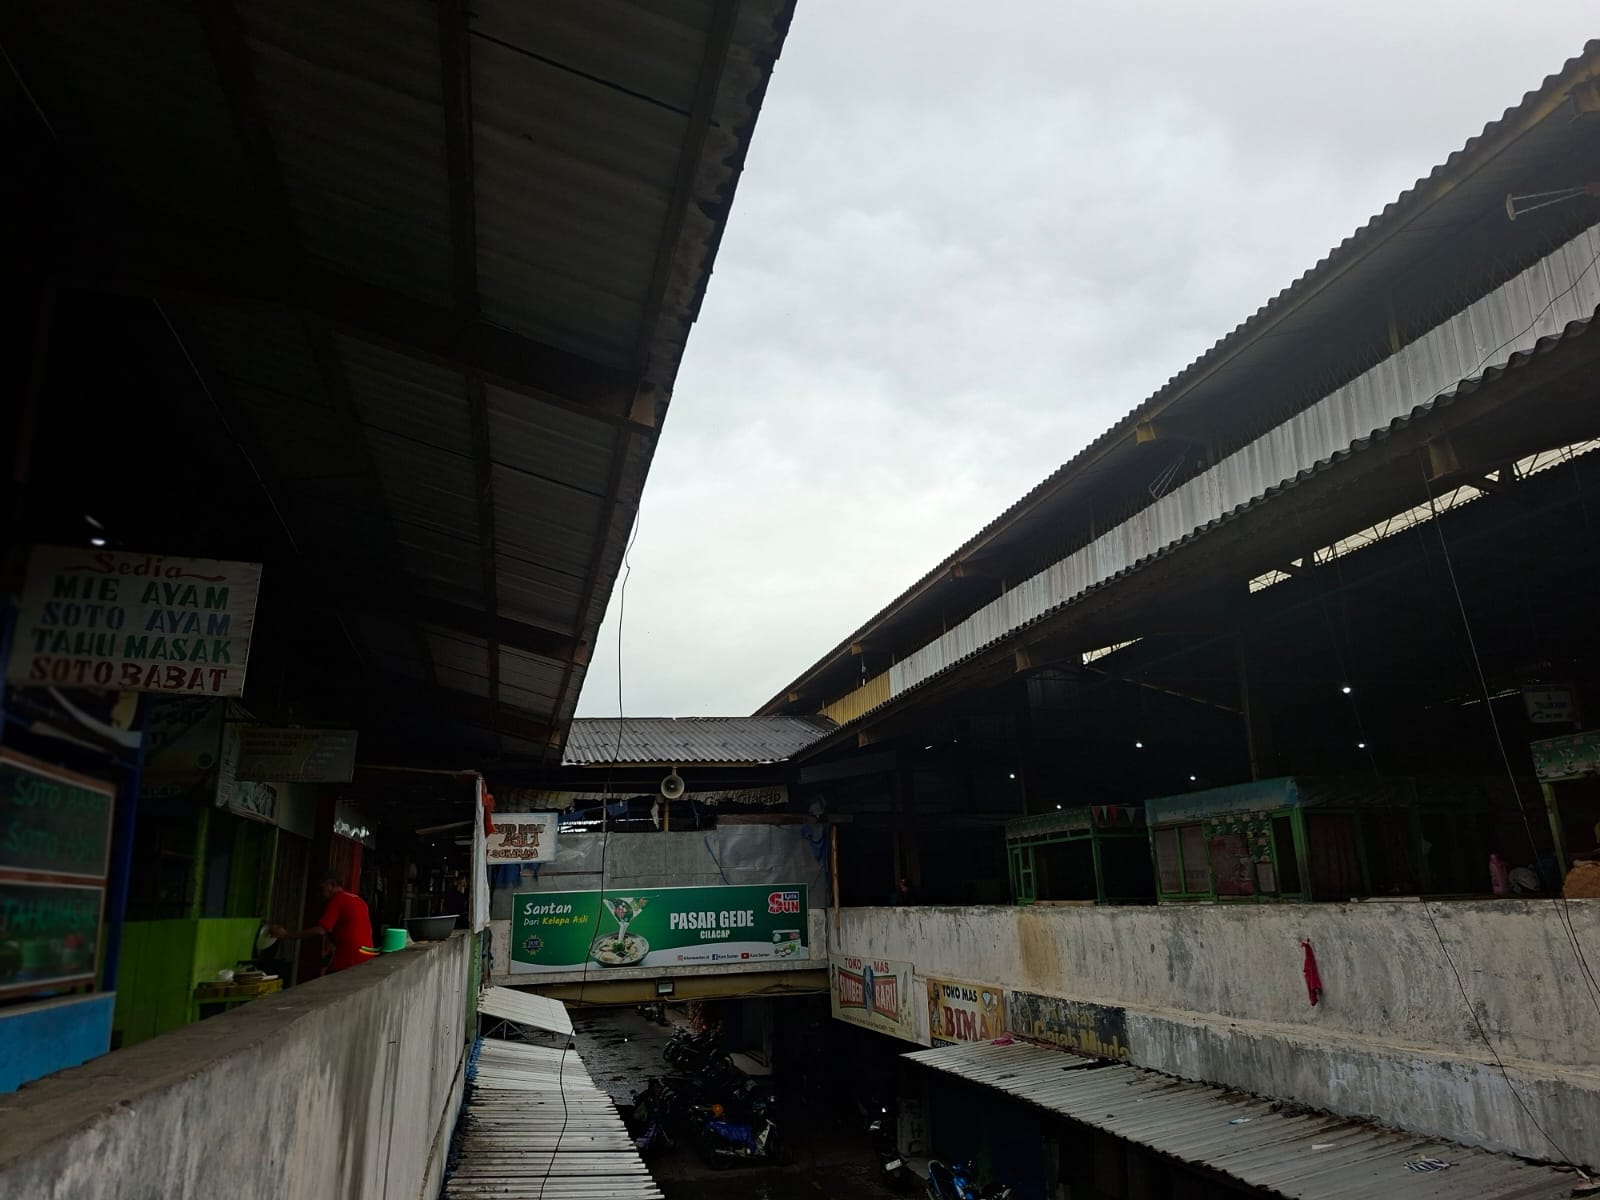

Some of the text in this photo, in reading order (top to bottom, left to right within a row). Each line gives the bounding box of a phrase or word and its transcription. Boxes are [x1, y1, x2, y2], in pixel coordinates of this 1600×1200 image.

[95, 553, 184, 578] Sedia
[53, 575, 229, 610] MIE AYAM
[42, 601, 230, 636] SOTO AYAM
[31, 628, 231, 664] TAHU MASAK
[30, 657, 227, 692] SOTO BABAT
[523, 902, 572, 915] Santan
[523, 915, 589, 926] Dari Kelapa Asli
[669, 910, 755, 930] PASAR GEDE
[700, 929, 731, 939] CILACAP
[845, 957, 890, 974] TOKO MAS
[840, 974, 897, 1014] SUMBER BARU
[942, 984, 978, 1003] TOKO MAS
[943, 1005, 993, 1042] BIMA
